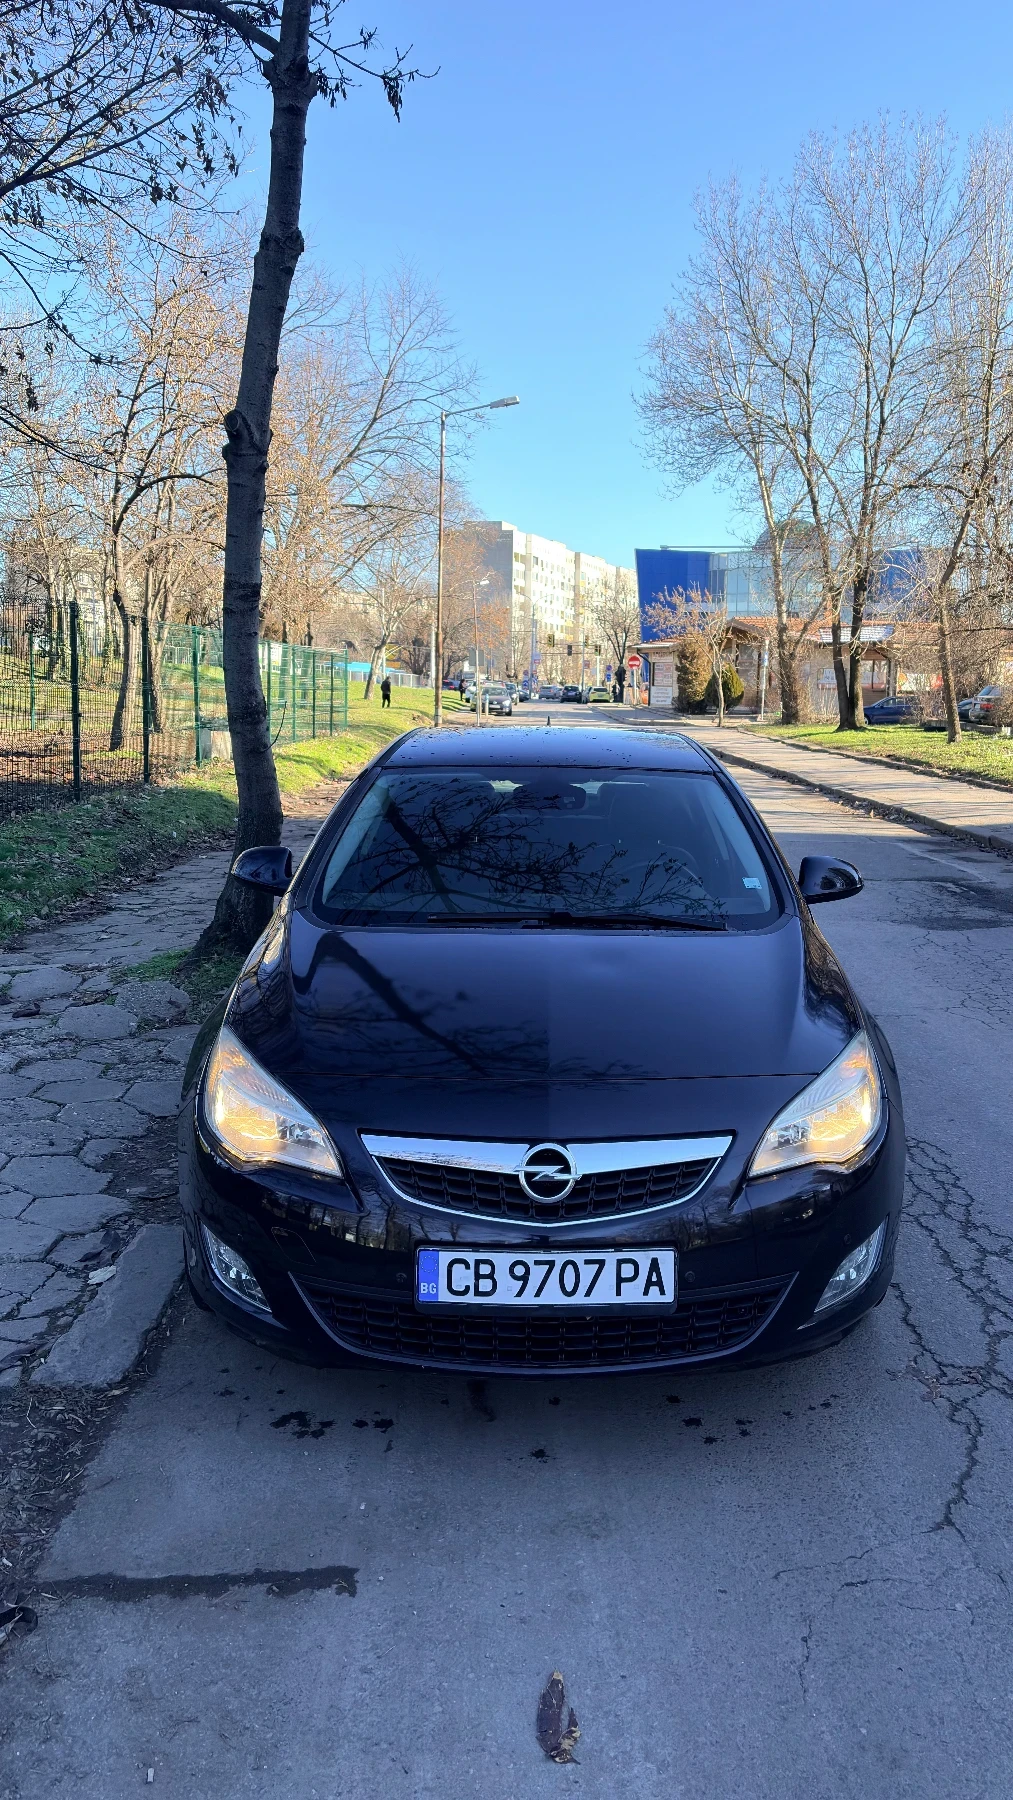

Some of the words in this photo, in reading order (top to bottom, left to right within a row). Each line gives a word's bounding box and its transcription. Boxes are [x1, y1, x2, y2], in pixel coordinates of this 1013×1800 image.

[420, 1283, 437, 1294] BG
[446, 1258, 498, 1298] CB
[508, 1259, 606, 1298] 9707
[615, 1257, 666, 1297] PA
